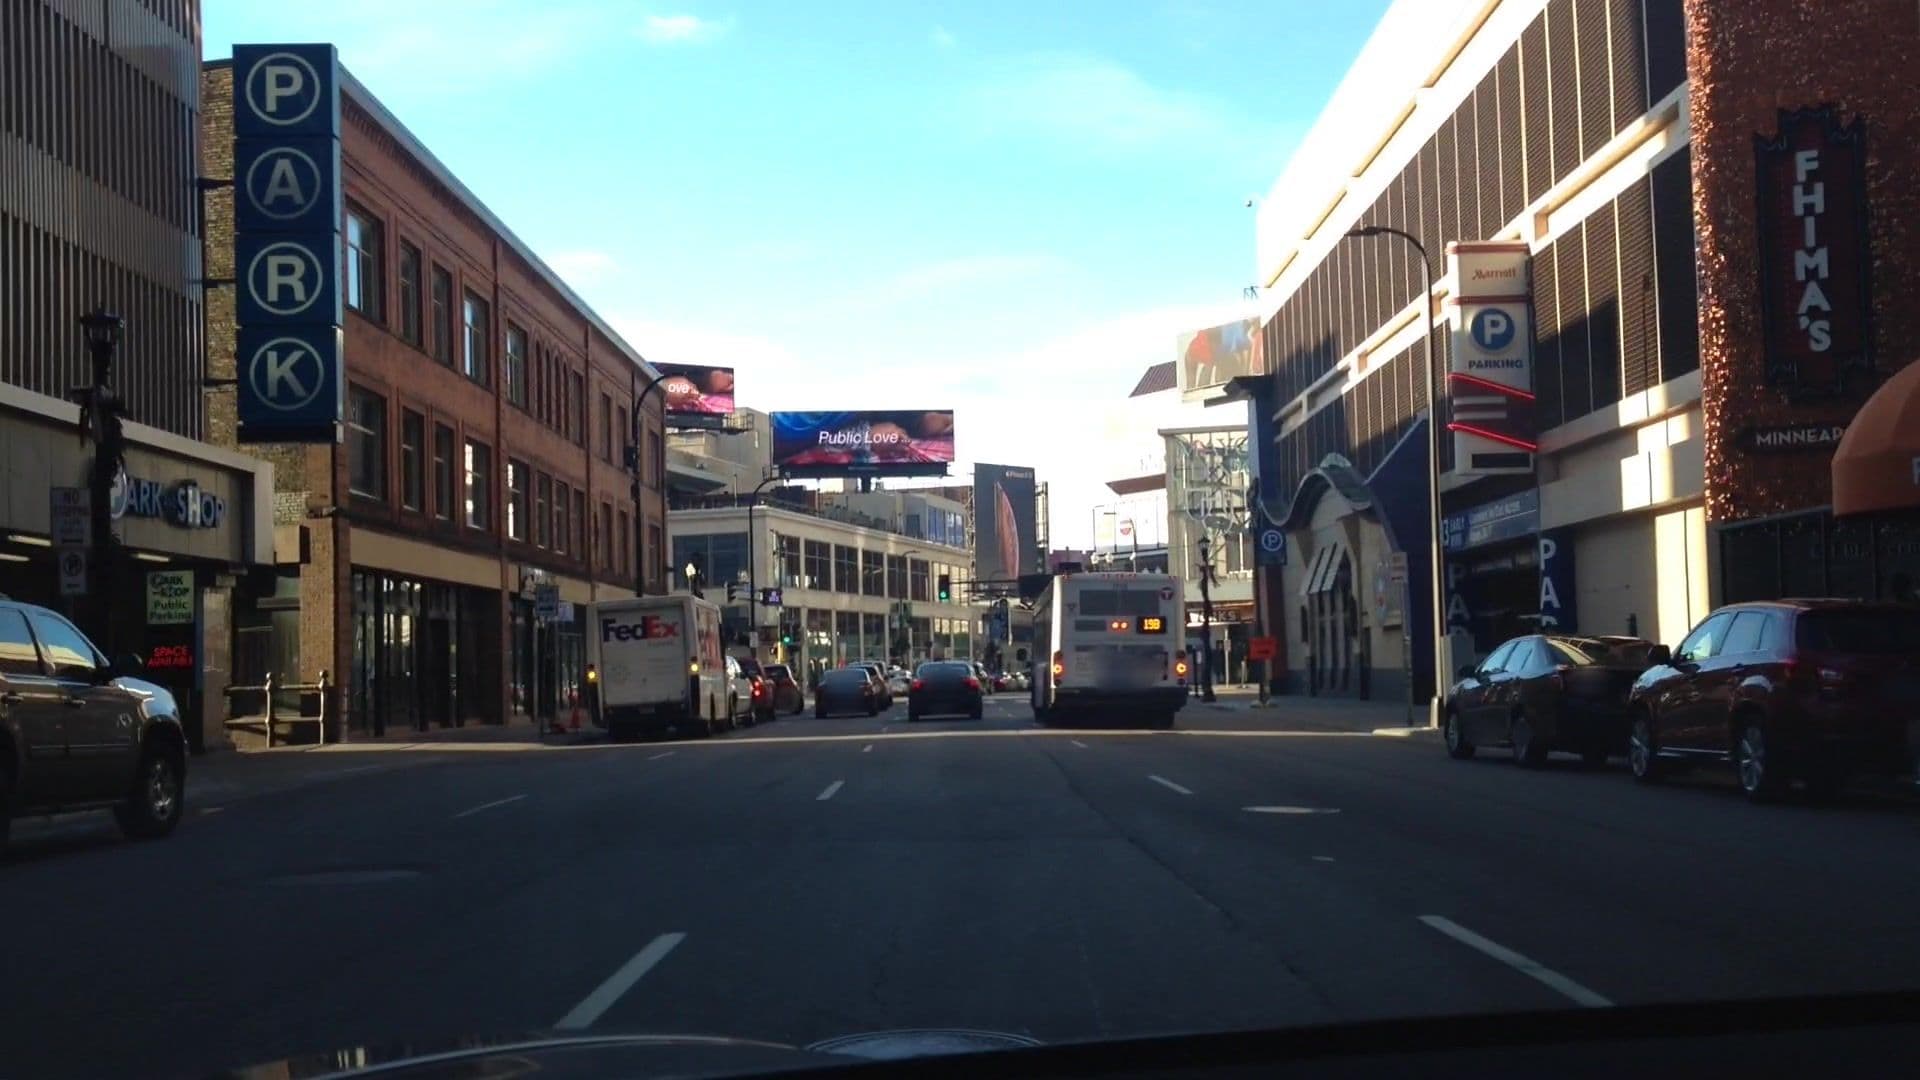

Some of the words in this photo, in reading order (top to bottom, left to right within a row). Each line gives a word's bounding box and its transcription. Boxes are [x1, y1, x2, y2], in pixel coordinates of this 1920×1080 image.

[264, 65, 308, 399] PARK
[1792, 150, 1833, 351] FHIMA'S
[1472, 267, 1516, 280] Marriott
[1483, 314, 1507, 344] P
[1468, 359, 1523, 370] PARKING
[818, 430, 861, 446] Public
[864, 431, 899, 444] Love
[1755, 427, 1846, 446] MINNEAP
[177, 484, 226, 528] SHOP
[154, 599, 187, 610] Public
[602, 616, 679, 642] FedEx
